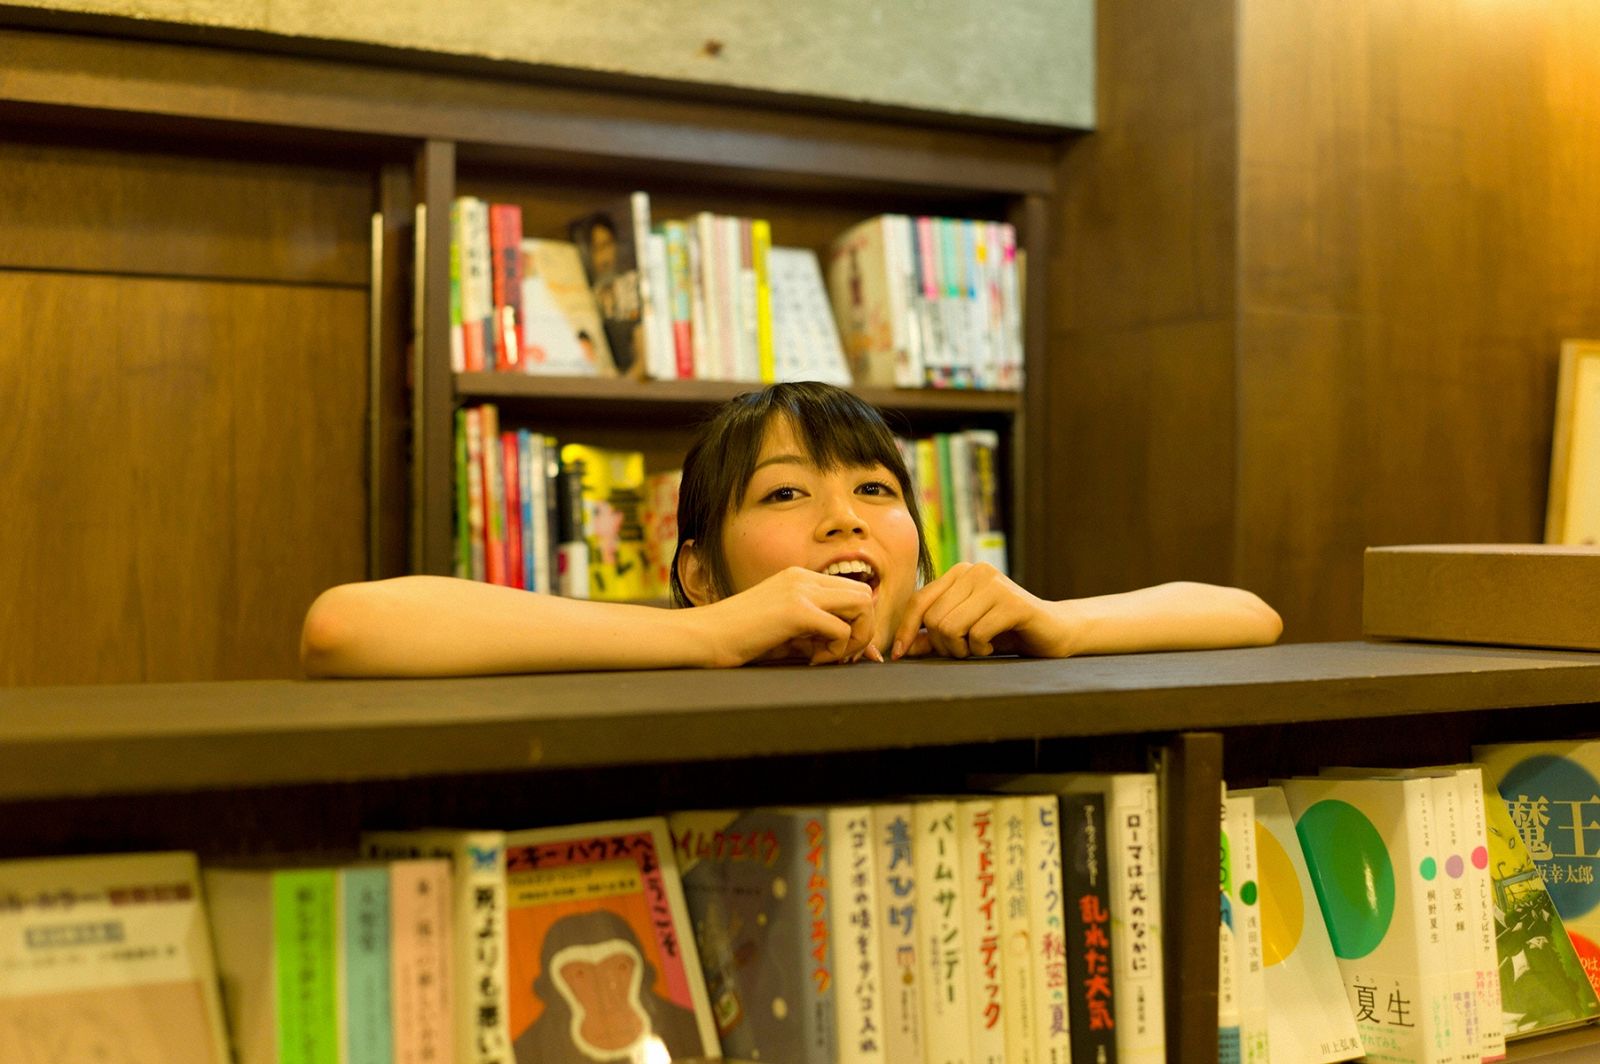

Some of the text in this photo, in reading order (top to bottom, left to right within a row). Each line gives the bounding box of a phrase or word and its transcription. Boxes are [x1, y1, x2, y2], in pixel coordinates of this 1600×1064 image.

[884, 815, 914, 937] 青ひげ
[1503, 794, 1600, 861] 魔王
[1126, 814, 1147, 971] ローマは光のなかに
[475, 886, 502, 1064] 死よりも悪い
[1079, 894, 1115, 1031] 乱れた大気
[1353, 983, 1415, 1028] 夏生
[1321, 1037, 1359, 1055] 川上弘美
